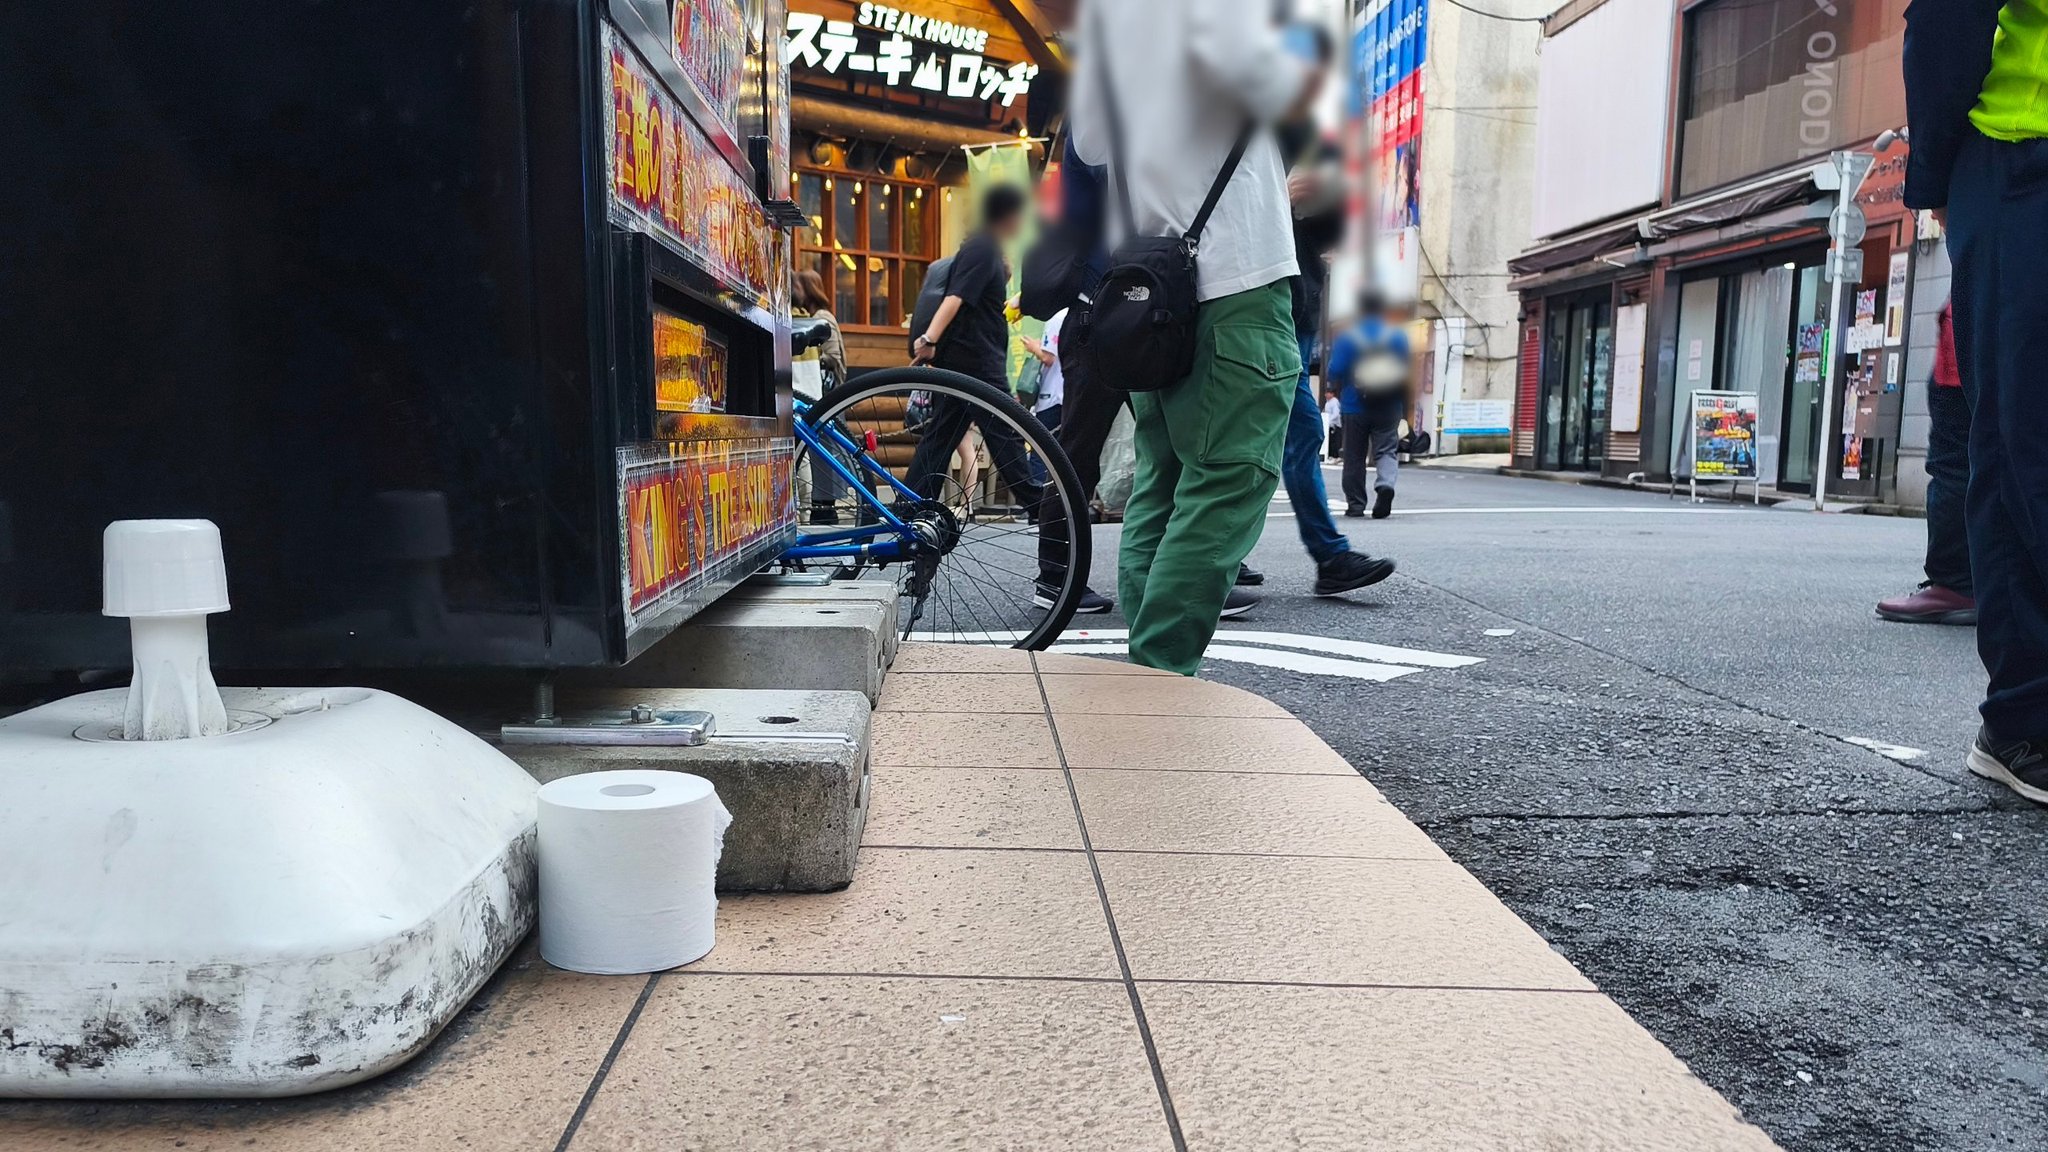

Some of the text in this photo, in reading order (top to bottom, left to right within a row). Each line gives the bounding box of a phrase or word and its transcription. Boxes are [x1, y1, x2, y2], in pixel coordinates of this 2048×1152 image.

[786, 12, 913, 86] ステーキ
[947, 53, 1039, 107] ロッヂ
[858, 1, 989, 52] STEAK HOUSE
[629, 468, 706, 594] KING'S
[709, 463, 774, 552] TREASURE
